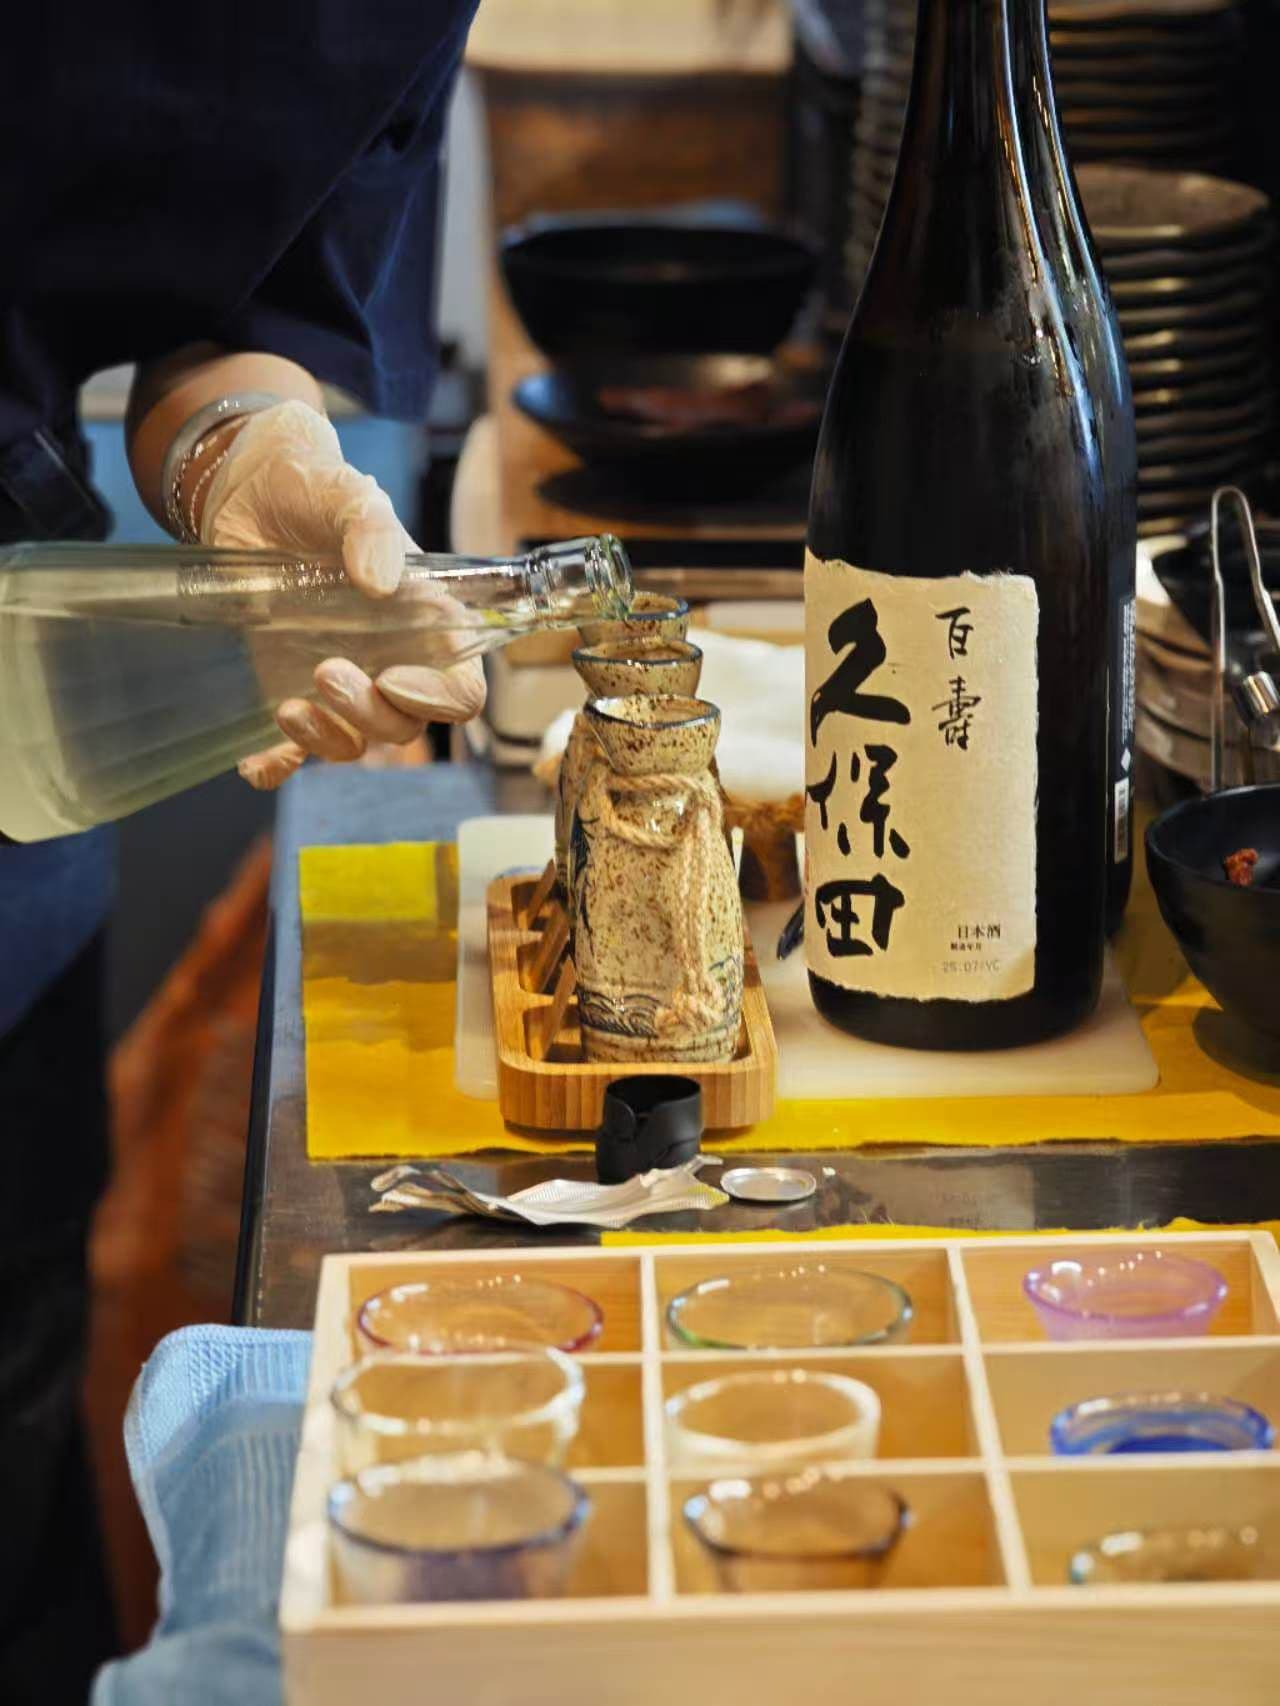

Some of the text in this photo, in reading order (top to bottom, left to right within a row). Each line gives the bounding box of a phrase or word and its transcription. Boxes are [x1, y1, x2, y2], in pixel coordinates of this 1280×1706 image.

[806, 598, 912, 957] 久保田
[958, 924, 1001, 939] 日本酒
